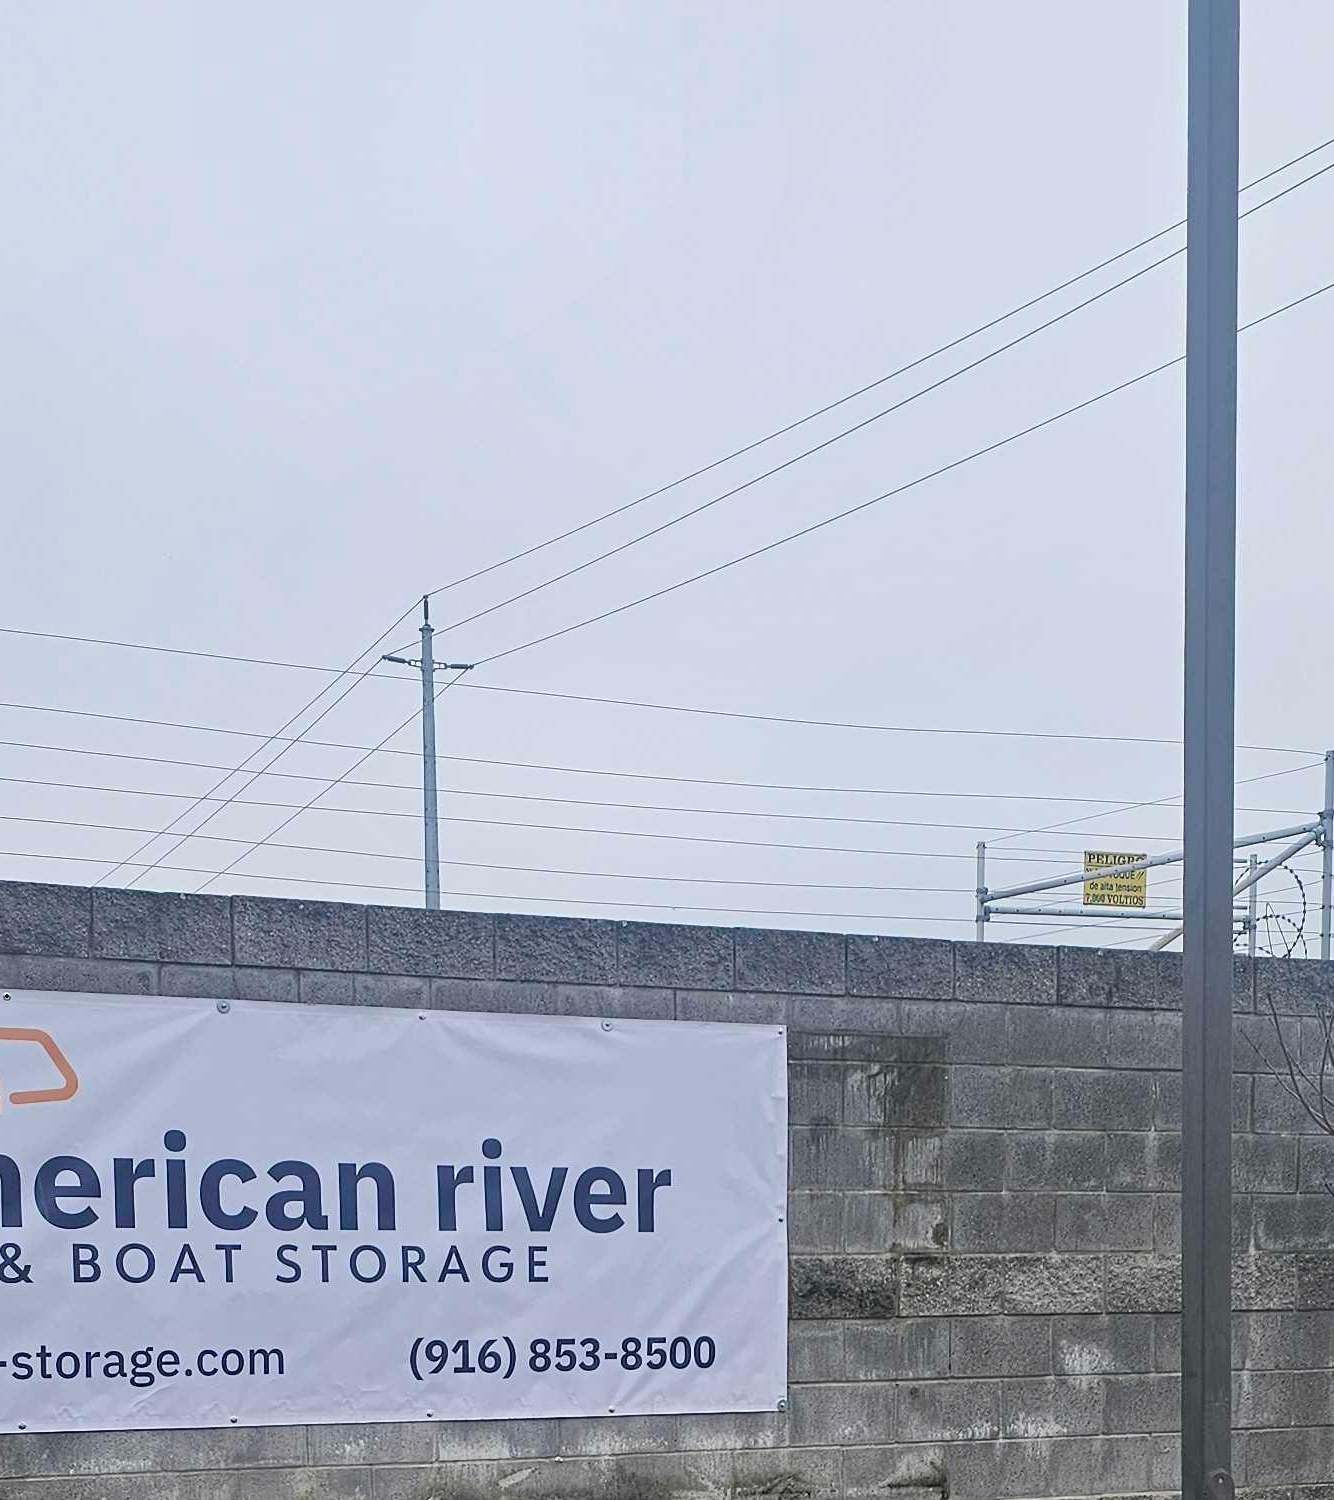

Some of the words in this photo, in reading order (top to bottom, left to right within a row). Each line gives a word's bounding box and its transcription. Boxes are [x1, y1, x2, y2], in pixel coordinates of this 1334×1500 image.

[1089, 881, 1099, 890] de
[1107, 894, 1144, 906] VOLTIOS
[436, 1137, 672, 1233] river
[72, 1242, 242, 1285] BOAT
[275, 1243, 551, 1285] STORAGE
[409, 1336, 517, 1380] (916)
[528, 1336, 716, 1372] 853-8500
